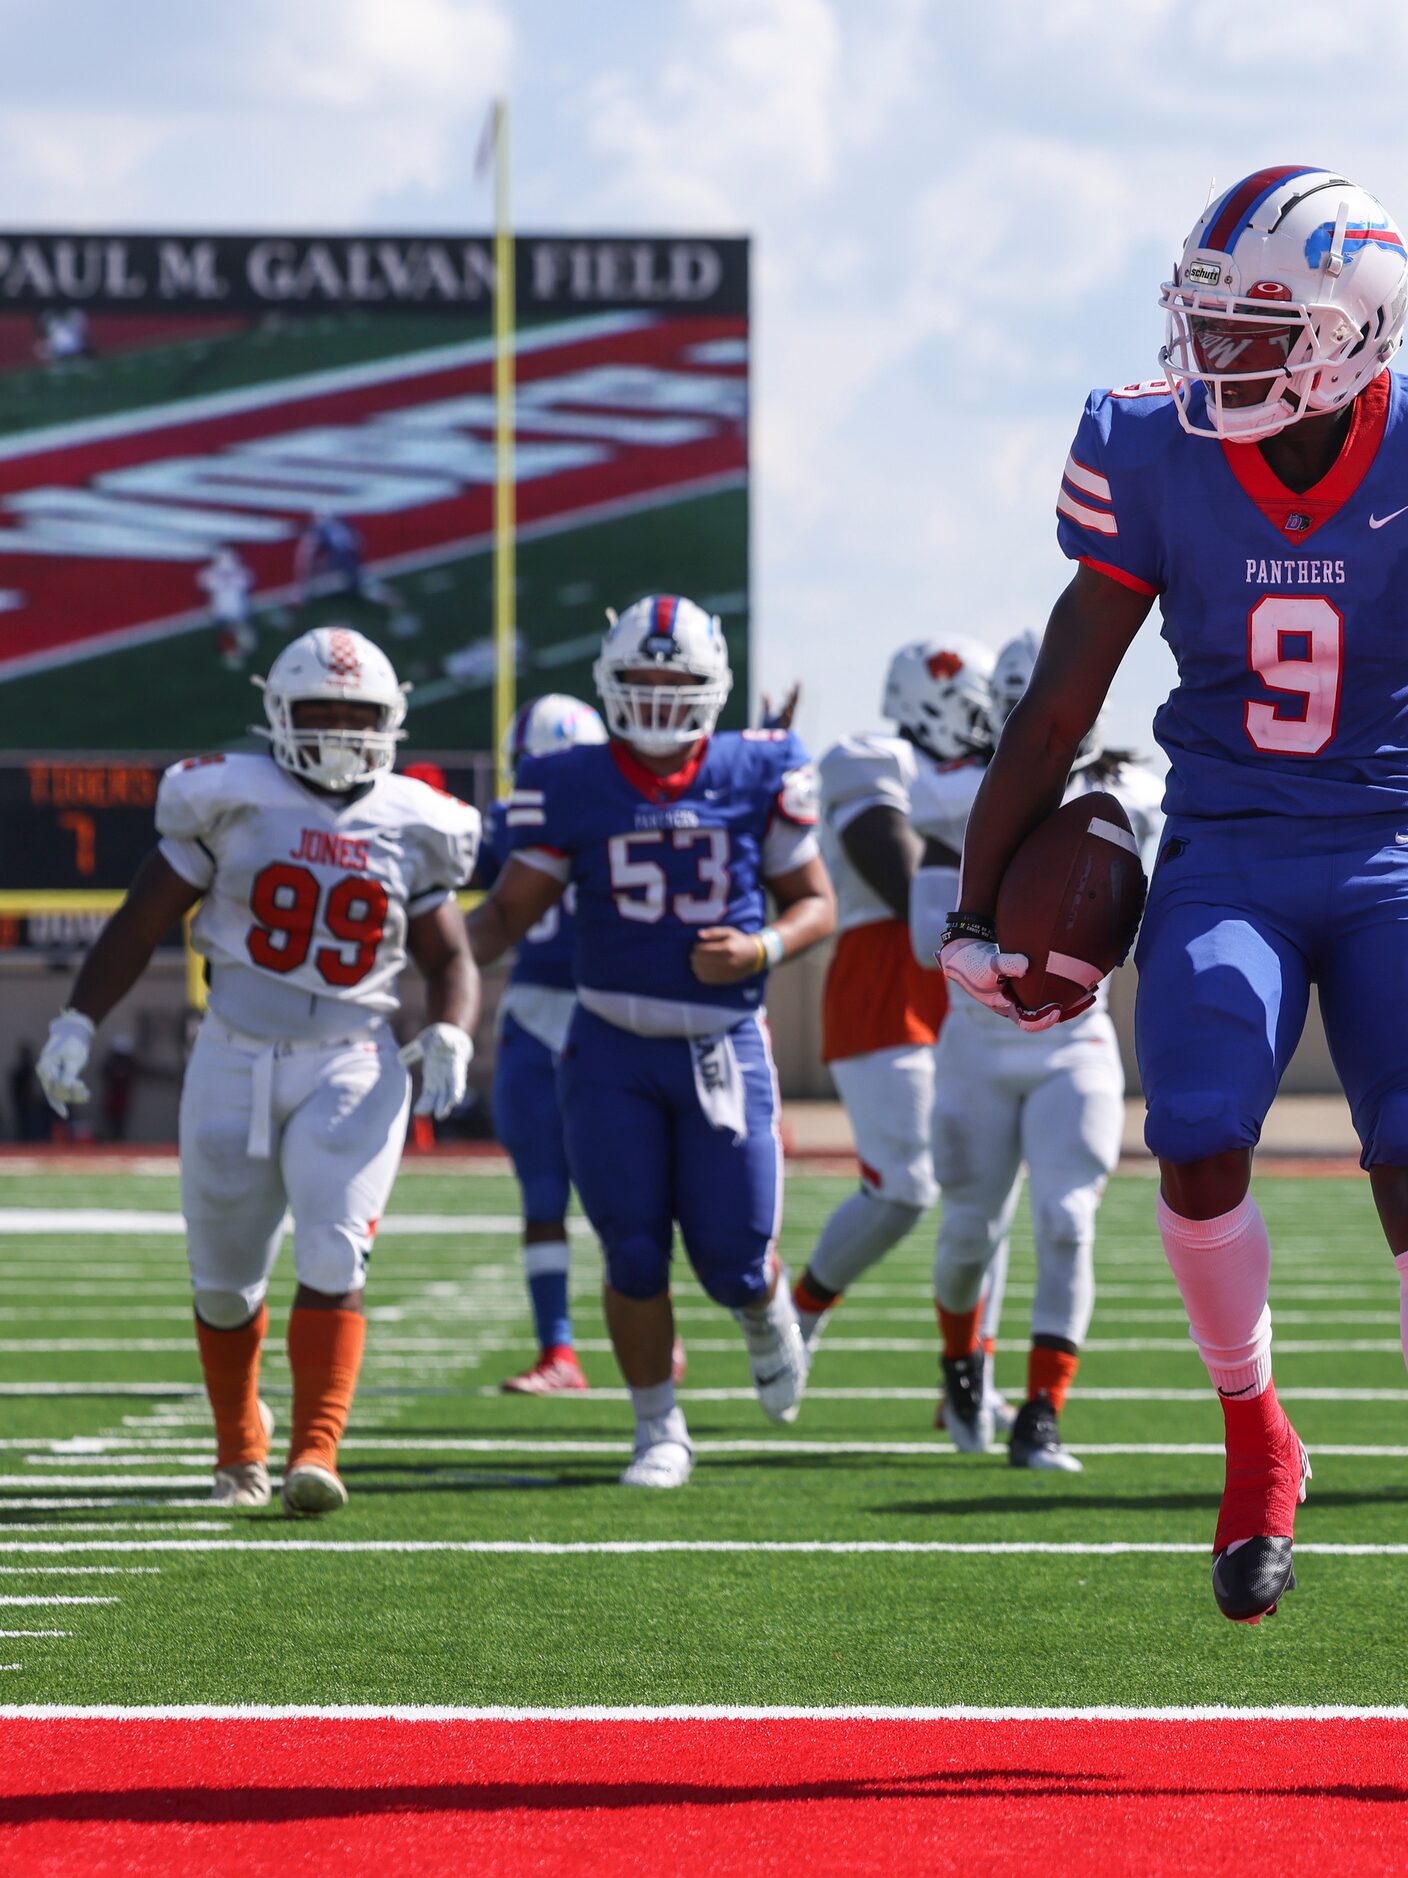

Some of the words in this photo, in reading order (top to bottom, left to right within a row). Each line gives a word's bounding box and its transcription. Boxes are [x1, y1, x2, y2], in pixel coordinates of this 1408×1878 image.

[533, 240, 722, 301] FIELD
[1191, 267, 1218, 281] schutt
[1245, 559, 1346, 584] PANTHERS
[1243, 593, 1345, 757] 9
[290, 828, 371, 871] JONES
[608, 828, 732, 925] 53
[246, 861, 389, 987] 99
